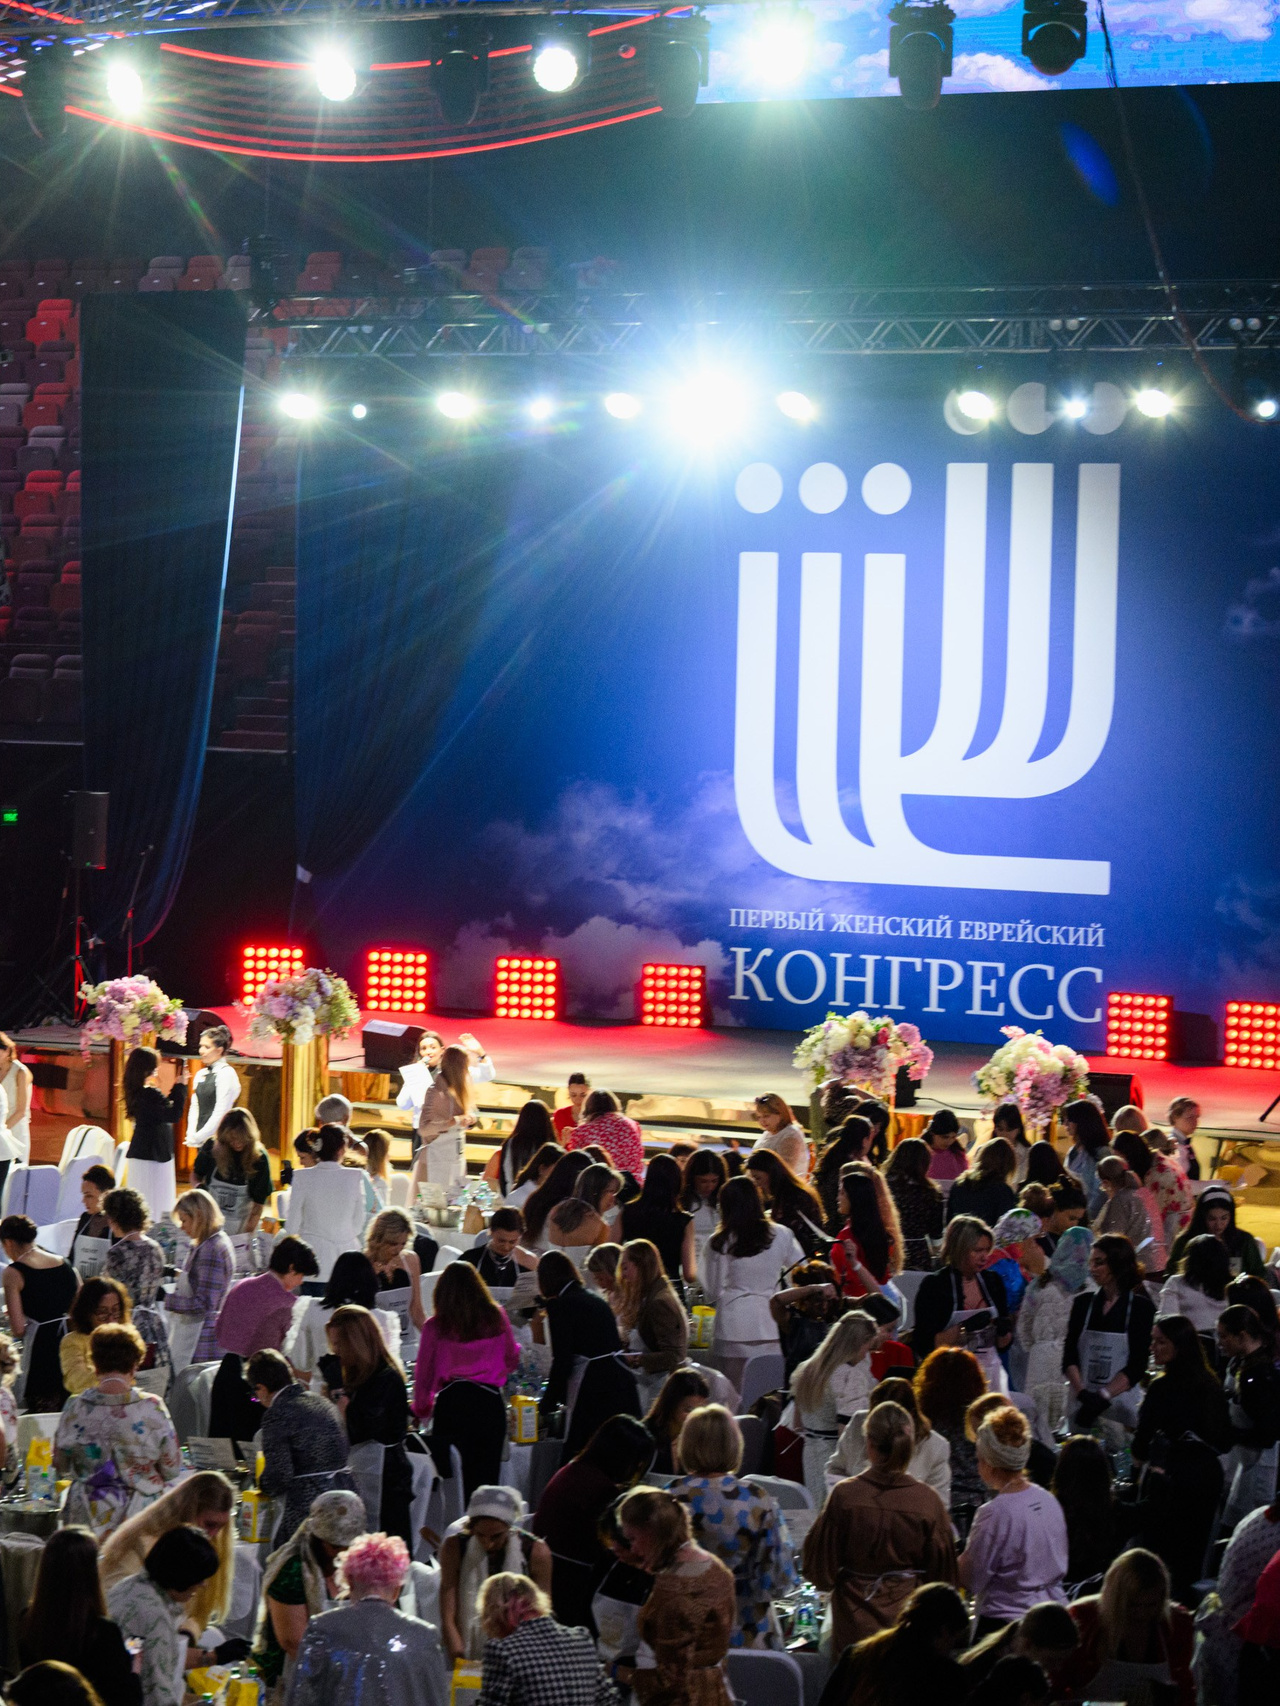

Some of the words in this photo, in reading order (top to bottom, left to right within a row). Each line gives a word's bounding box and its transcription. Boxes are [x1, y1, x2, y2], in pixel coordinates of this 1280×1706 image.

[729, 908, 825, 931] ПЕРВЫЙ
[830, 914, 953, 939] ЖЕНСКИЙ
[958, 919, 1106, 947] ЕВРЕЙСКИЙ
[728, 946, 1104, 1023] КОНГРЕСС
